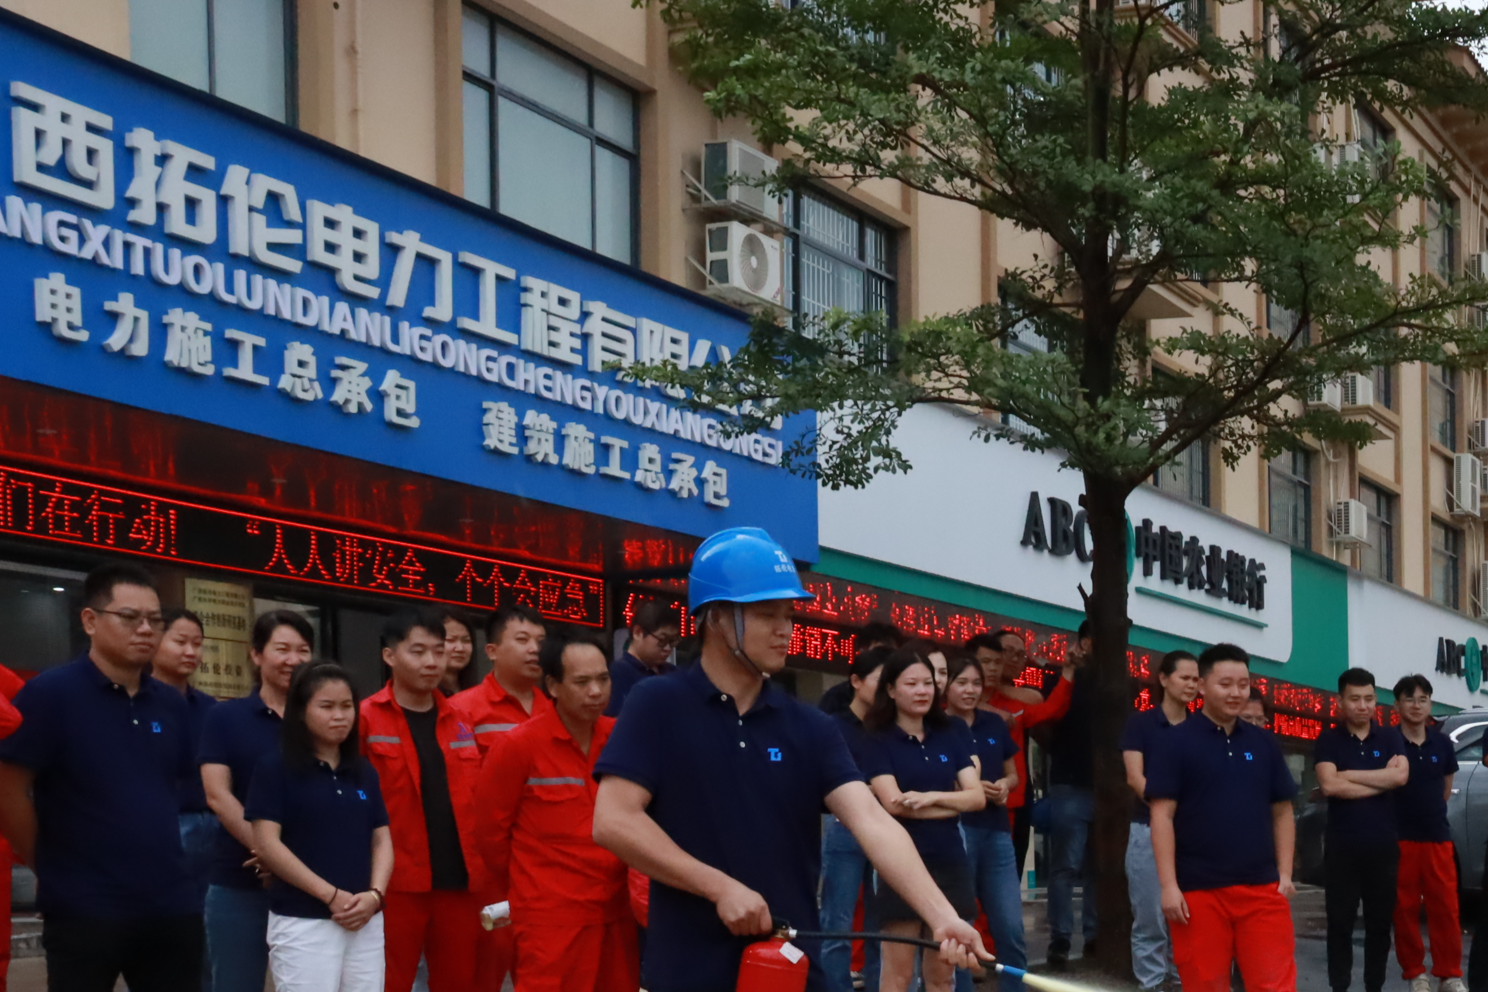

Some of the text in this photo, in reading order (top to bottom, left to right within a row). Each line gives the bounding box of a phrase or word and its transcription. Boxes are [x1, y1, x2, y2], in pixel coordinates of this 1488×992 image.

[34, 272, 730, 508] 电力施工总承包 建筑施工总承包
[1020, 490, 1094, 563] ABC
[1135, 517, 1267, 612] 中国农业银行
